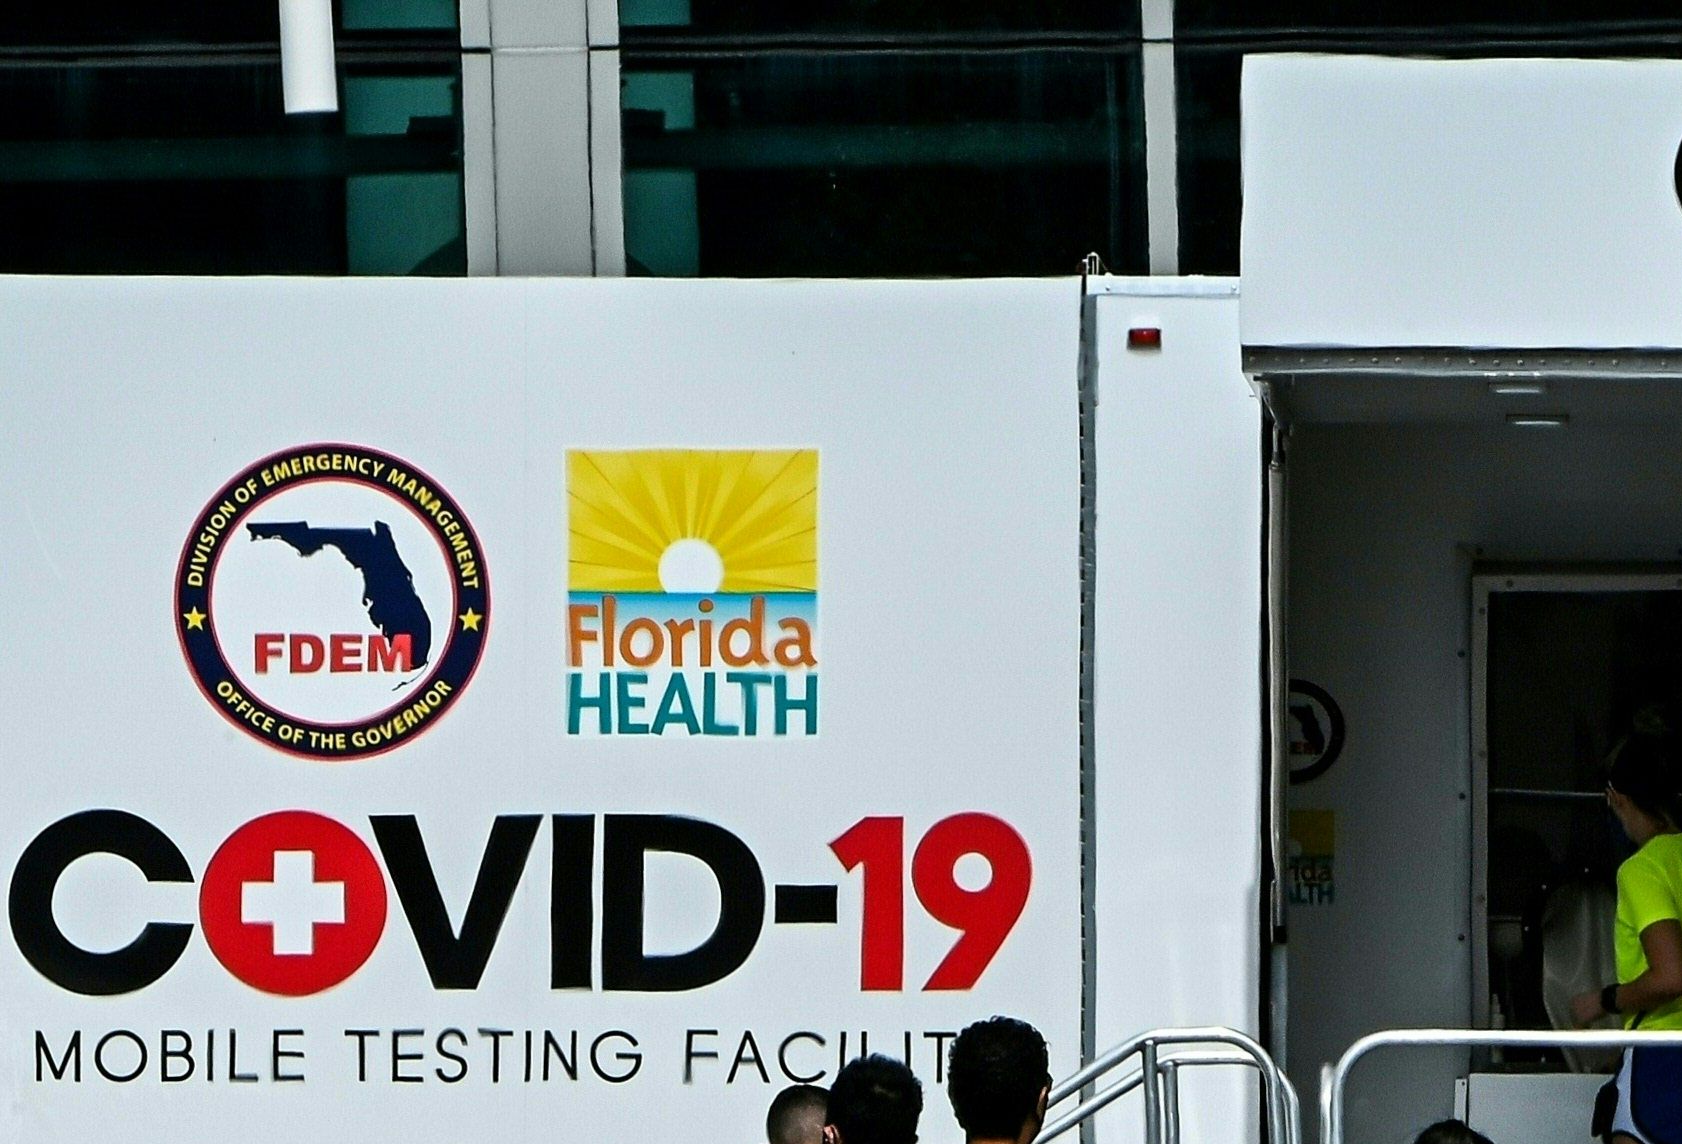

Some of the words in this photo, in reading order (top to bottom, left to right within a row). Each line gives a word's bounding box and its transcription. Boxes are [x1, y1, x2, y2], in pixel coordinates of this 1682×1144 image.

[187, 499, 237, 588] DIVISION
[233, 478, 259, 504] OF
[260, 452, 386, 487] EMERGENCY
[386, 467, 479, 590] MANAGEMENT
[254, 632, 414, 674] FDEM
[567, 597, 817, 669] Florida
[216, 680, 276, 734] OFFICE
[277, 722, 305, 745] OF
[308, 730, 347, 750] THE
[351, 678, 453, 748] GOVERNOR
[567, 671, 818, 737] HEALTH
[9, 808, 1032, 997] COVID-19
[34, 1028, 305, 1084] MOBILE
[345, 1028, 643, 1084] TESTING
